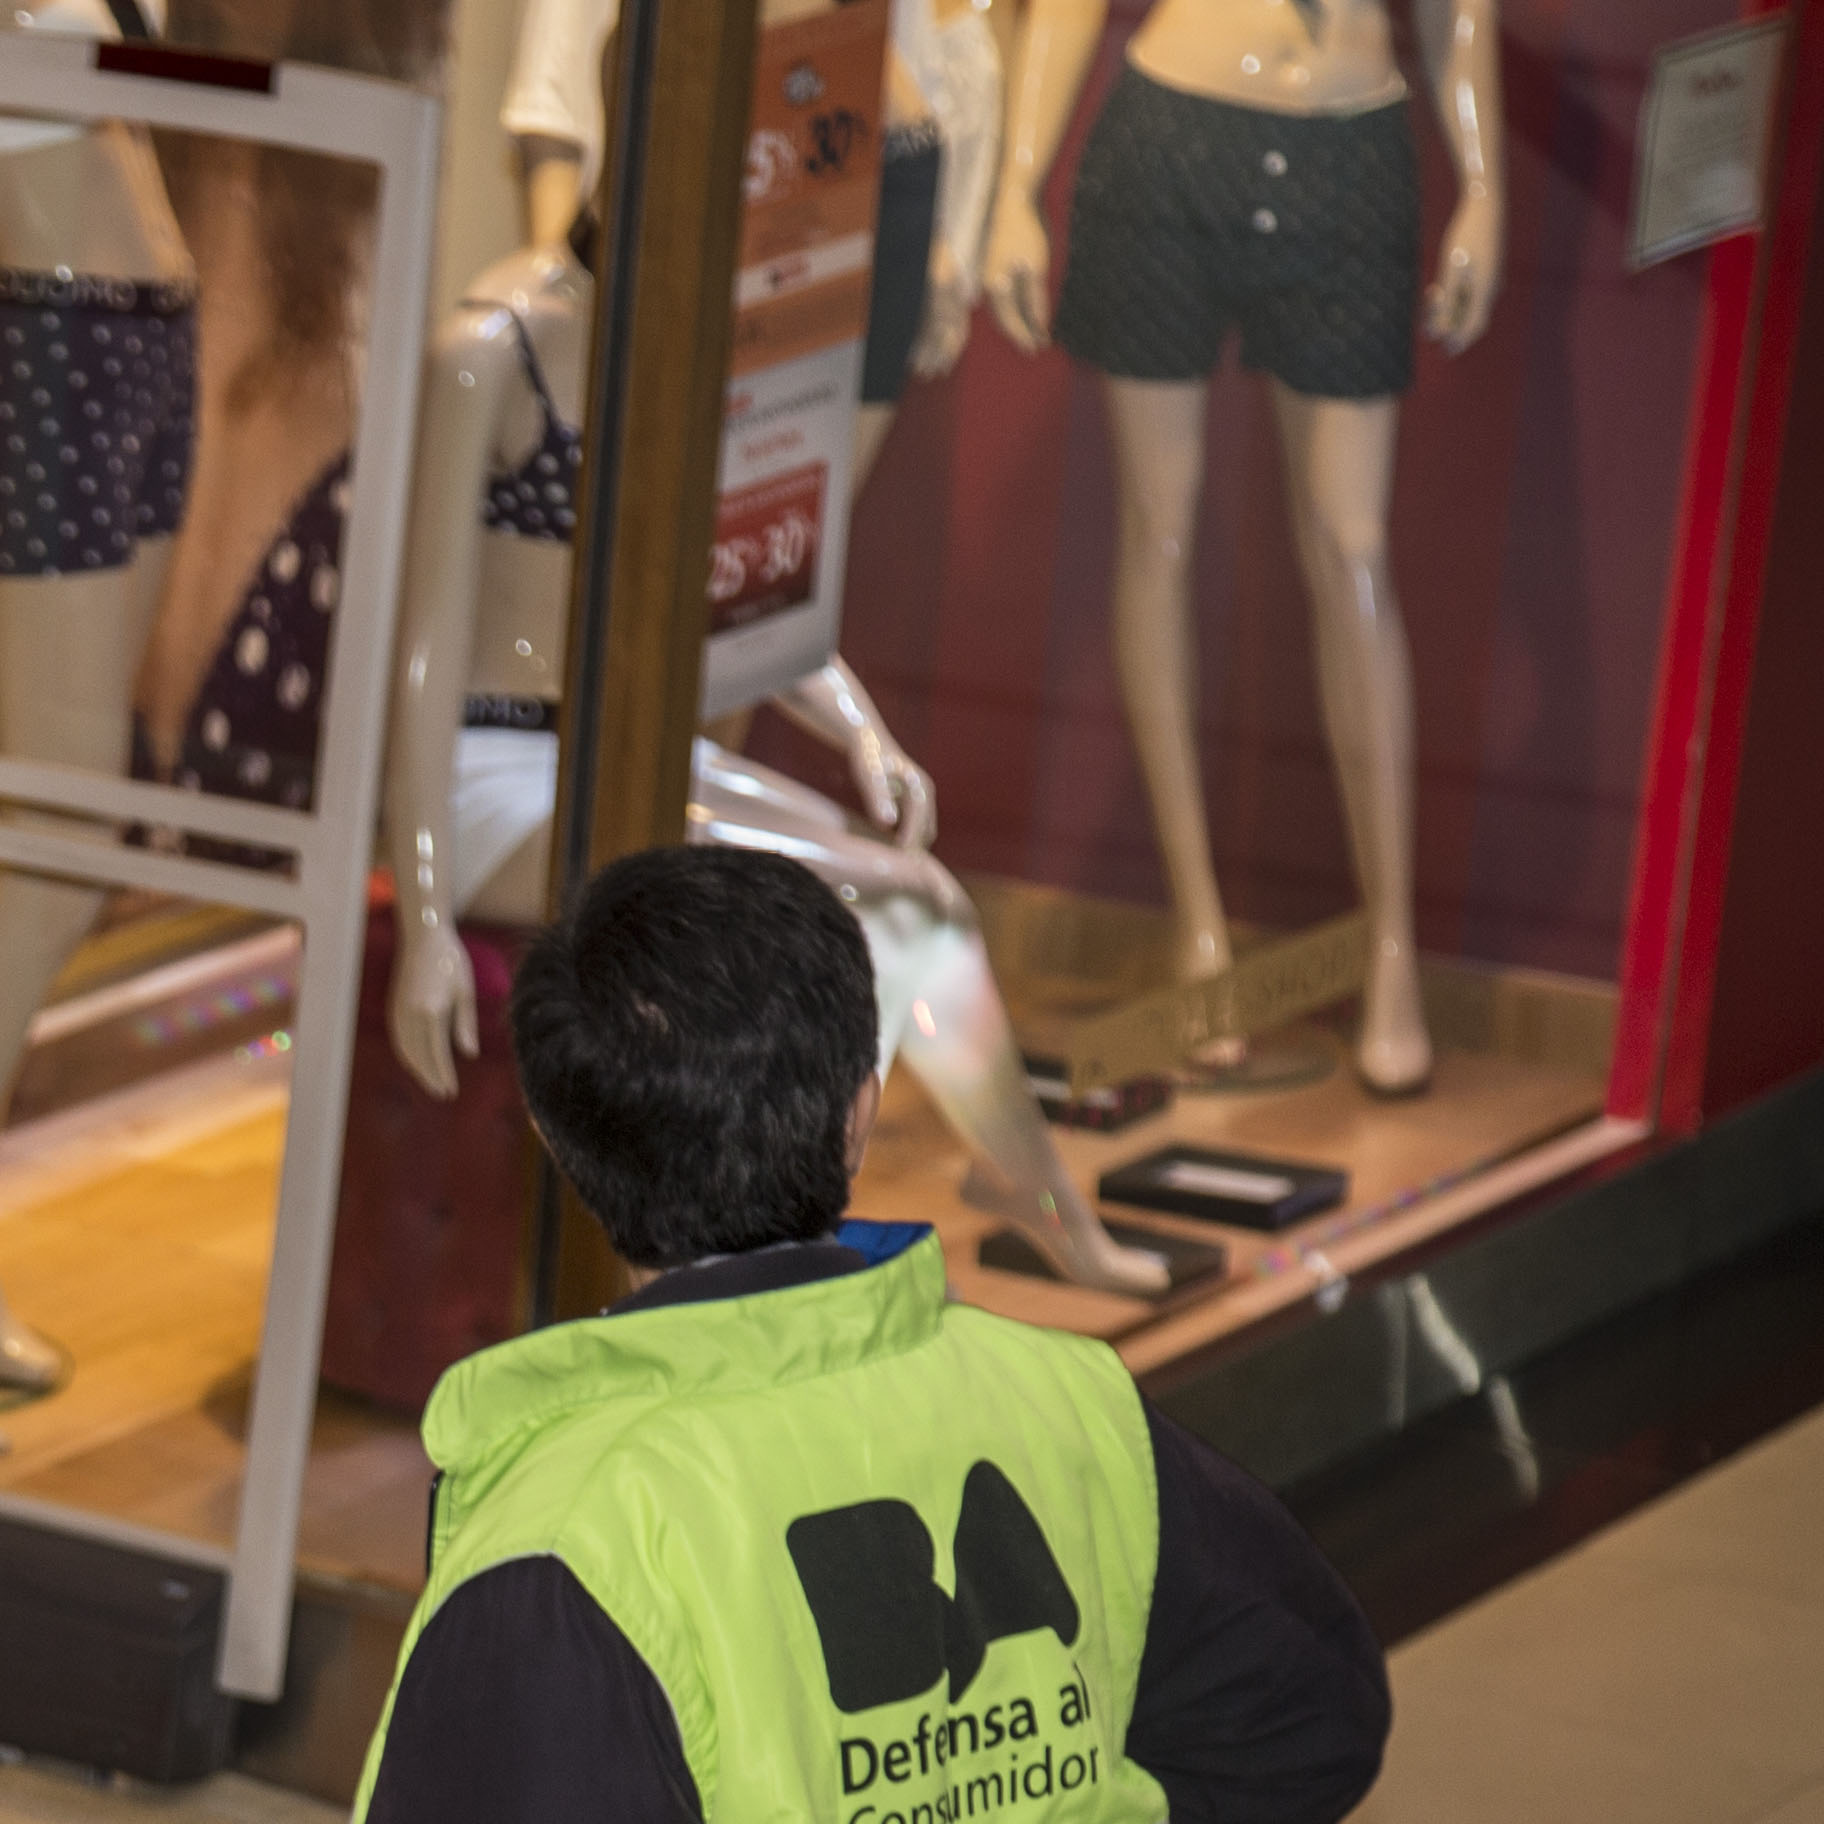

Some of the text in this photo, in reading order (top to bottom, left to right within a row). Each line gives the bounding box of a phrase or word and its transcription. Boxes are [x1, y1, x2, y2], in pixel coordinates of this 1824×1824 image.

[785, 1458, 1081, 1715] BA
[840, 1661, 1092, 1796] Defensa al
